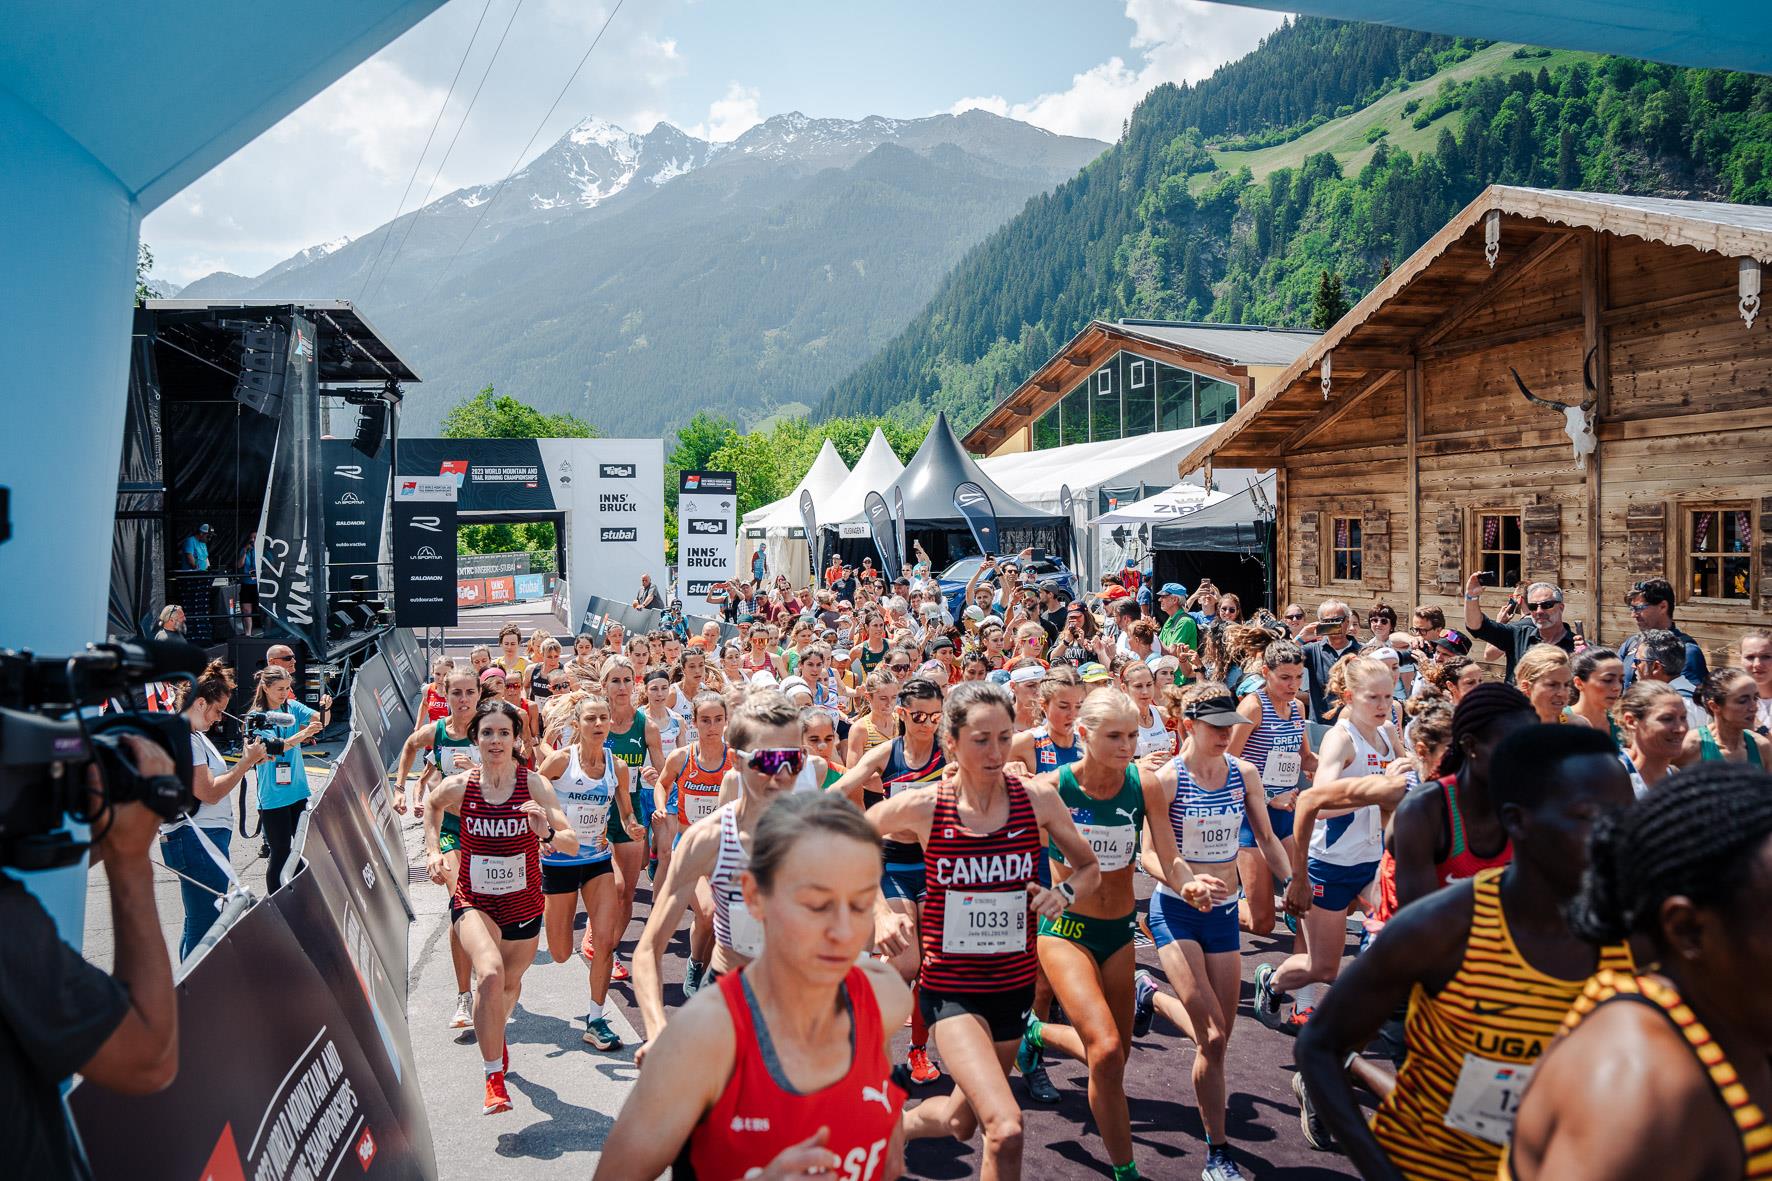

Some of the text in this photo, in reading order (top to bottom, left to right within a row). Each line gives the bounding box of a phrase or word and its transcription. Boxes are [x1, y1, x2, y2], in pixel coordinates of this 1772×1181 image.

[604, 466, 632, 476] Tirol
[600, 504, 636, 512] BRUCK
[693, 522, 722, 532] Tirol
[602, 530, 635, 540] stubai
[688, 558, 726, 567] BRUCK
[520, 580, 538, 594] stubai
[492, 590, 509, 600] BRUCK
[1274, 736, 1302, 745] GREAT
[1186, 804, 1242, 818] GREAT
[580, 814, 598, 824] 1006
[466, 816, 528, 837] CANADA
[1202, 828, 1230, 842] 1087
[486, 868, 513, 879] 1036
[936, 852, 1033, 884] CANADA
[968, 911, 1008, 928] 1033
[1050, 916, 1085, 938] AUS
[1475, 1032, 1542, 1059] UGA
[284, 1058, 330, 1141] MOUNTAIN
[321, 1040, 344, 1086] AND
[304, 1078, 358, 1178] CHAMPIONSHIPS
